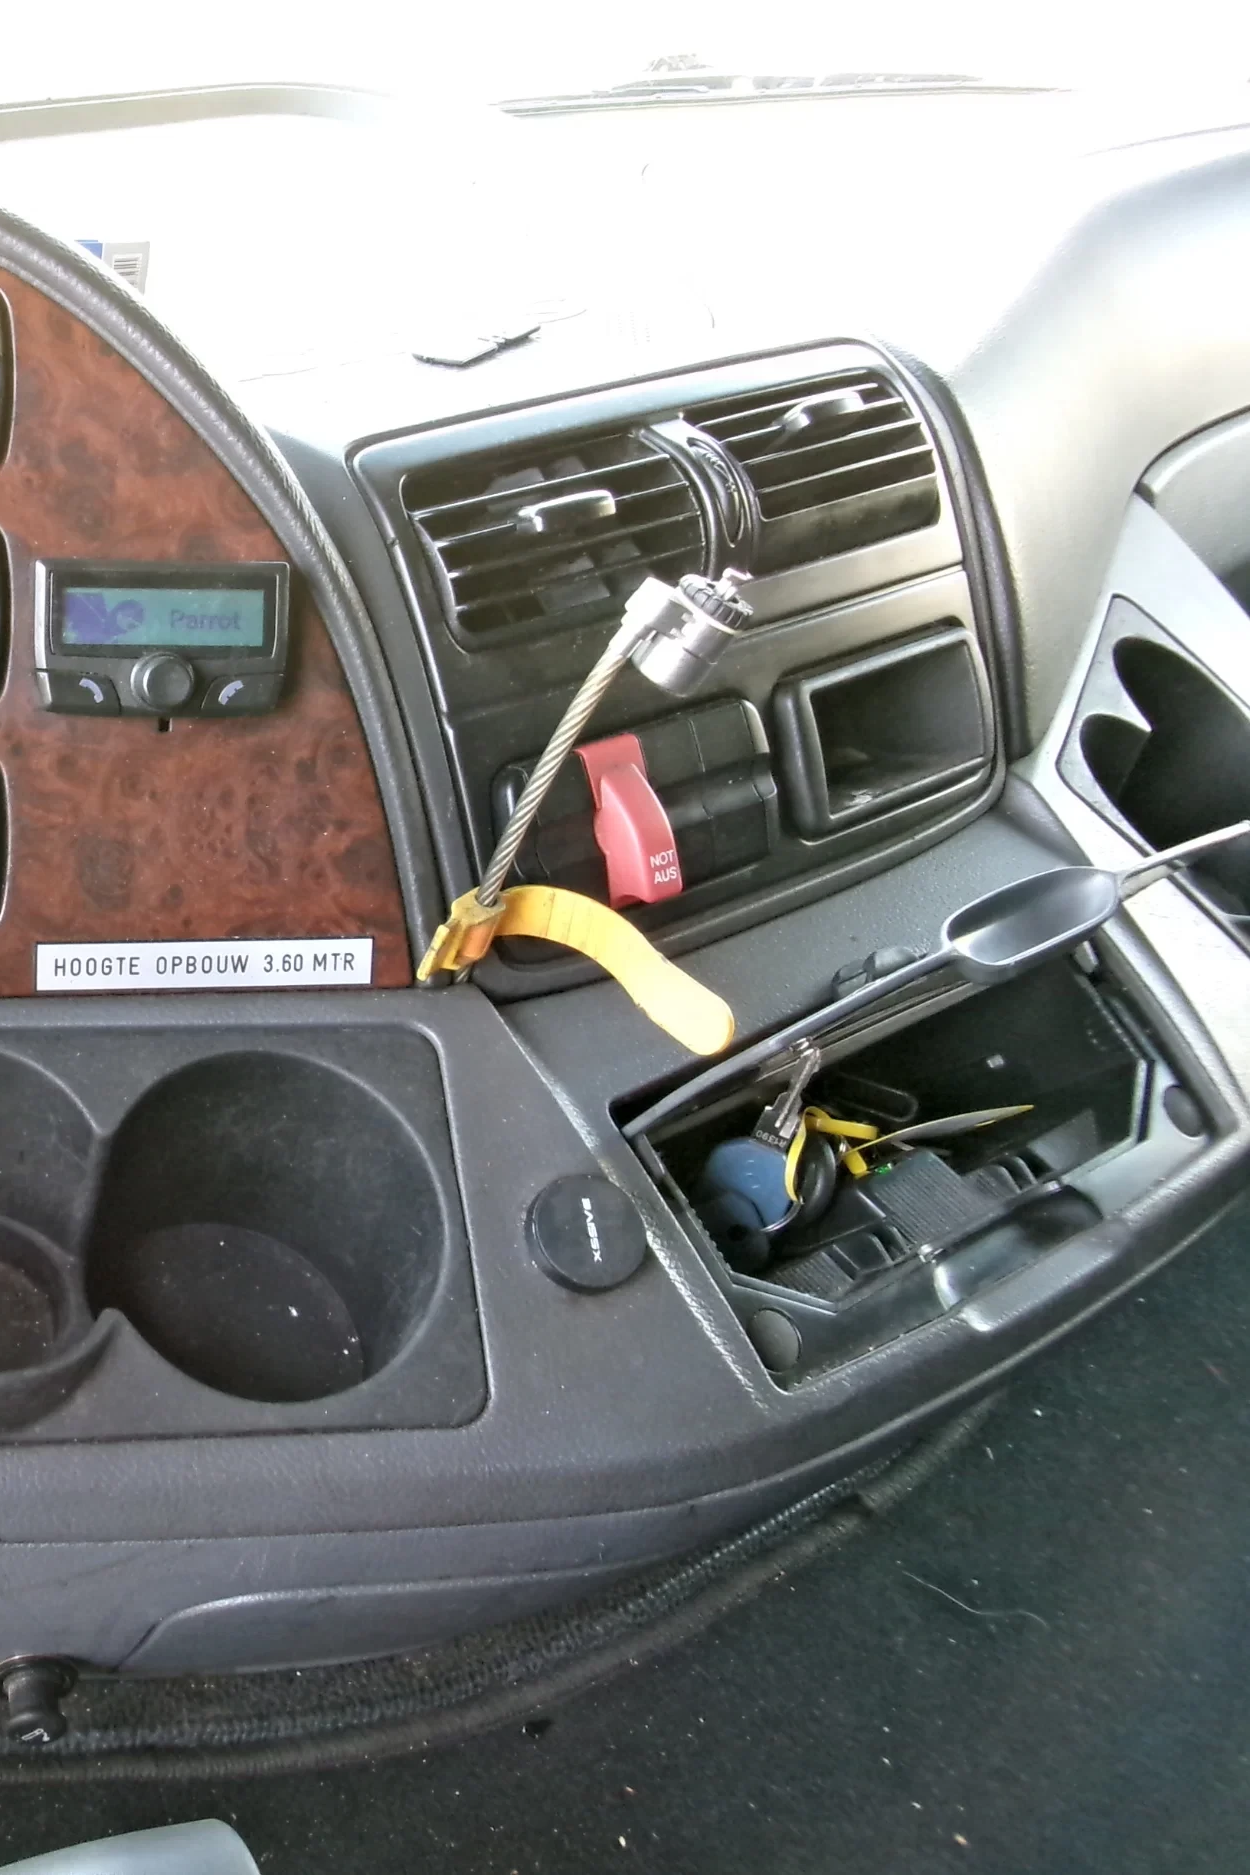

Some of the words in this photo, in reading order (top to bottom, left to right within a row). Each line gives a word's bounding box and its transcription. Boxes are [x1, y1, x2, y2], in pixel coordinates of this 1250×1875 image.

[170, 610, 241, 630] Parrot
[649, 849, 674, 869] NOT
[653, 866, 677, 885] AUS
[53, 956, 141, 977] HOOGTE
[155, 954, 249, 975] OPBOUW
[262, 953, 303, 973] 3.60
[312, 952, 355, 972] MTR
